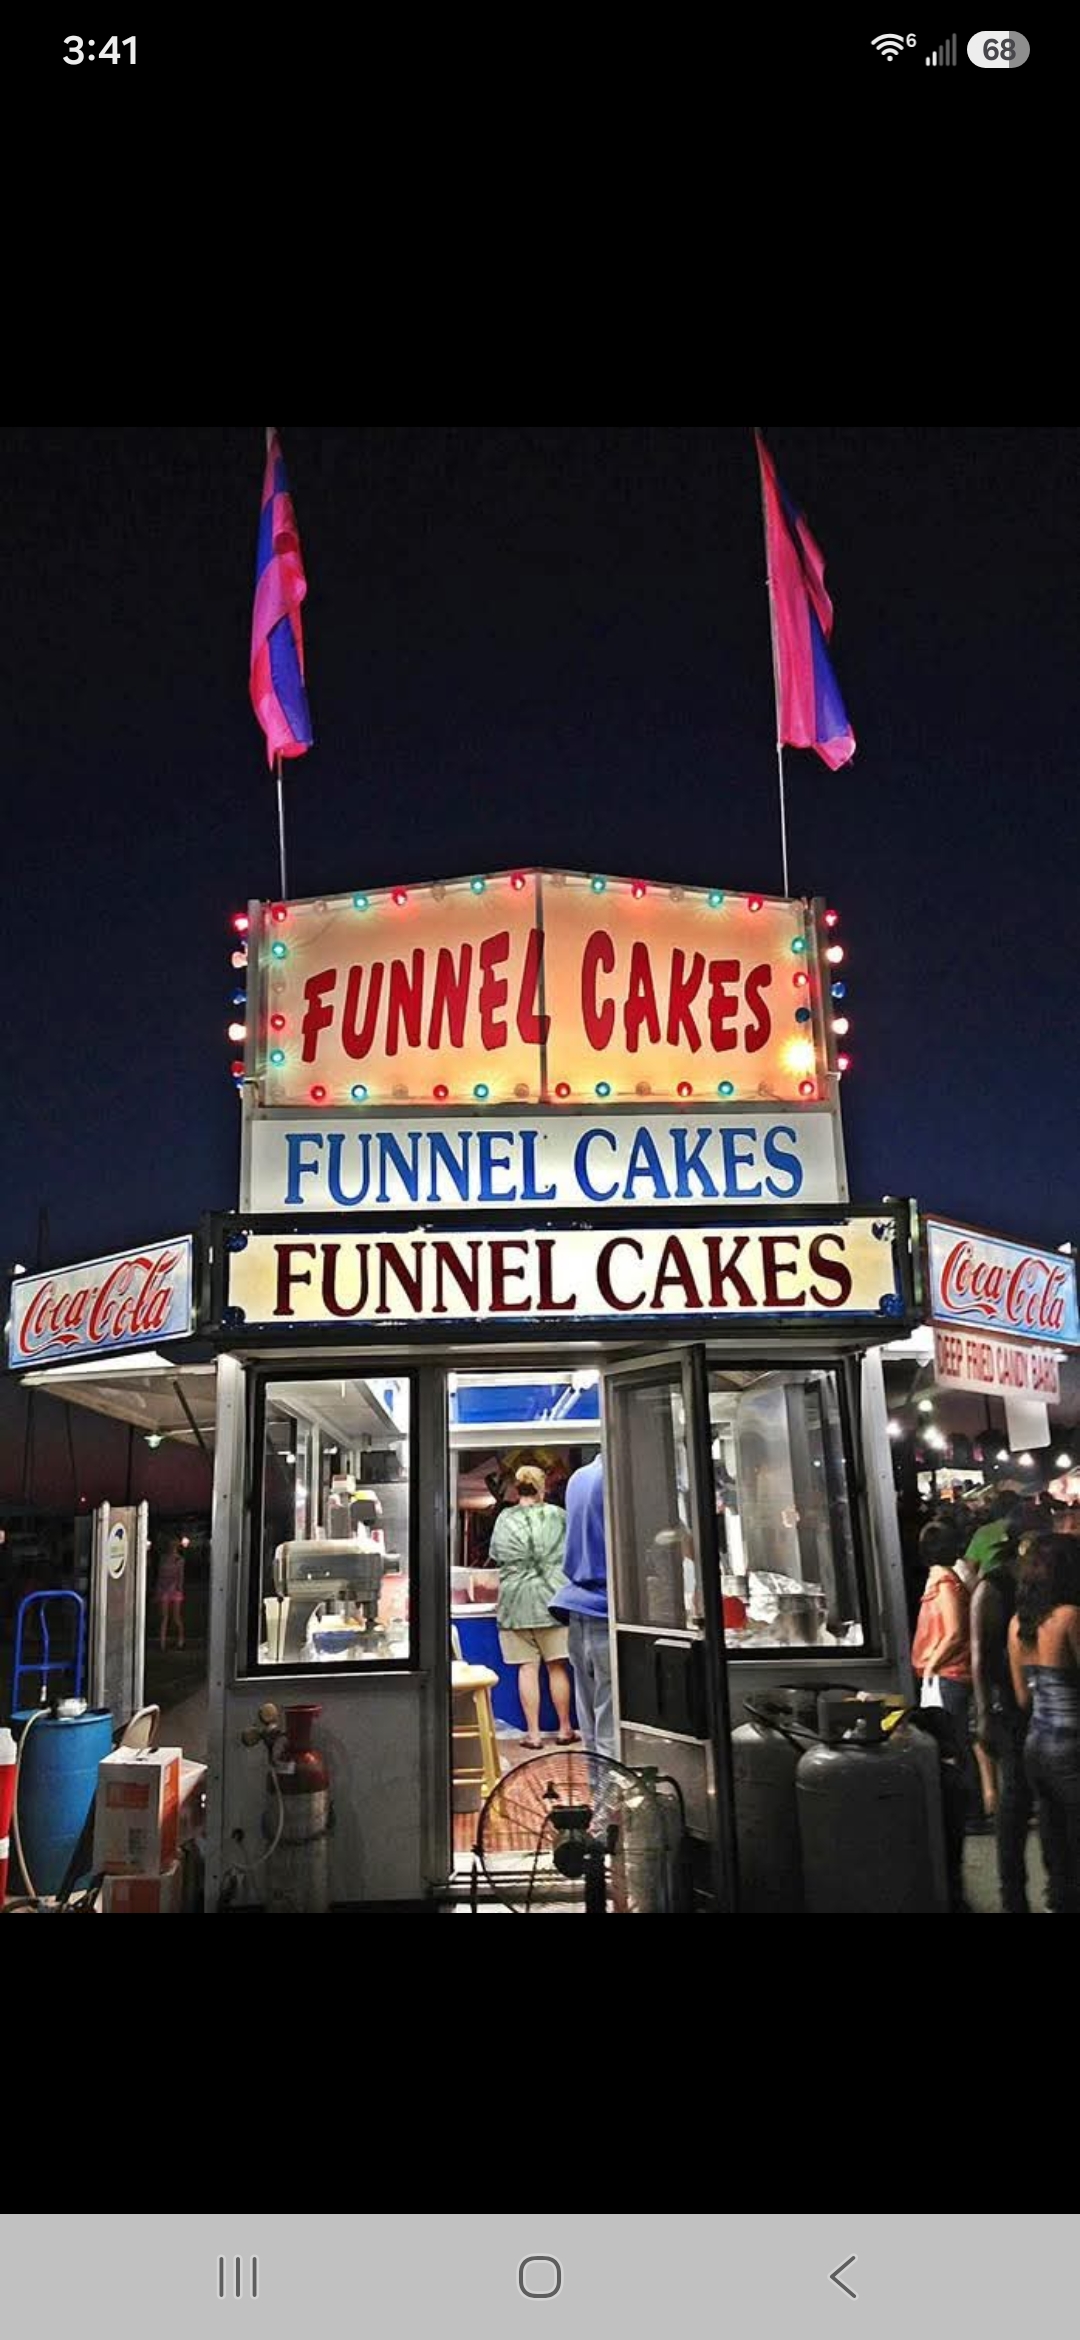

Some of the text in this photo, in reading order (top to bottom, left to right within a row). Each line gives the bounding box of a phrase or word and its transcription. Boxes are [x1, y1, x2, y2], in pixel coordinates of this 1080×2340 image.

[301, 927, 773, 1063] FUNNEL CAKES
[283, 1124, 804, 1205] FUNNEL CAKES
[19, 1250, 182, 1357] Coca-Cola
[272, 1232, 854, 1319] FUNNEL CAKES
[940, 1240, 1067, 1331] Coca-Cola
[937, 1334, 1058, 1394] DEEP FRIED CANDY BARS
